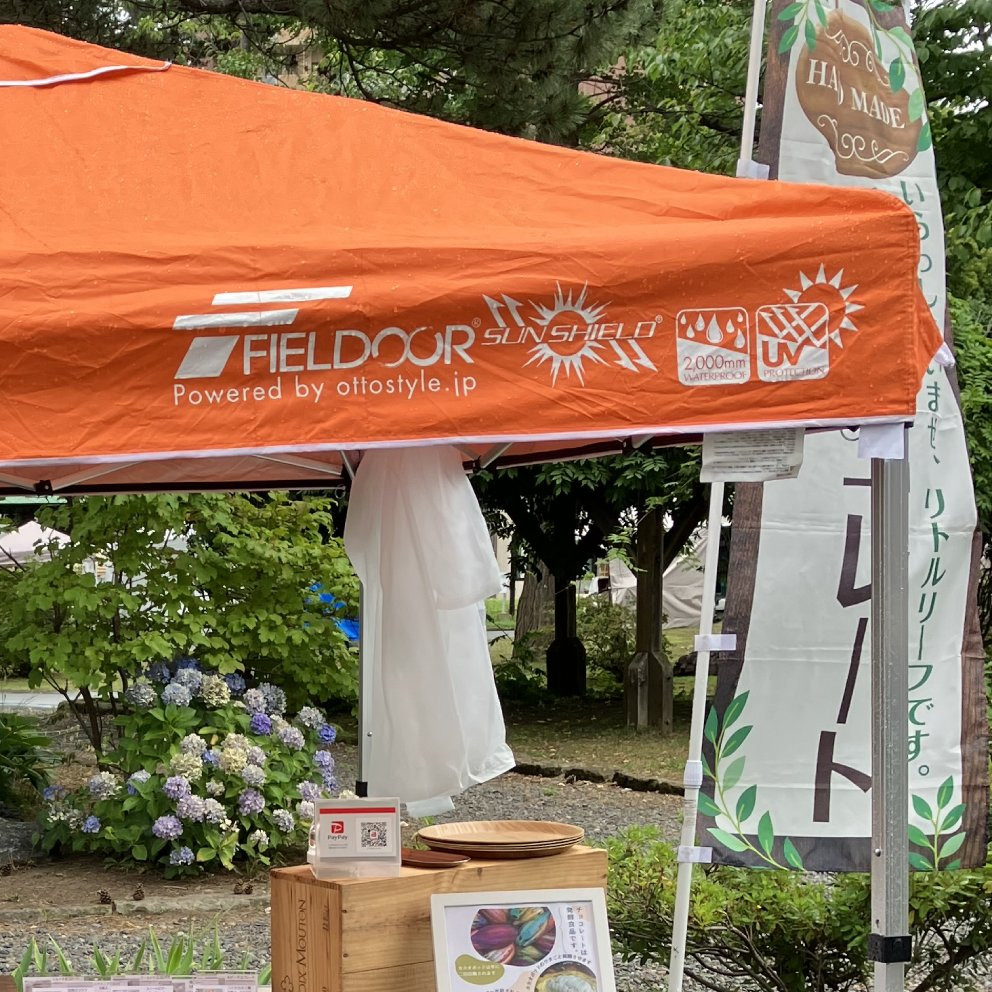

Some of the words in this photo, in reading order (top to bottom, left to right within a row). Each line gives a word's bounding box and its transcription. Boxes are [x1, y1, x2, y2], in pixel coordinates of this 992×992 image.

[851, 87, 906, 129] MADE
[480, 324, 548, 345] SUN
[550, 320, 657, 343] SHIELD
[683, 354, 746, 371] 2,000mm
[762, 339, 805, 368] UV
[173, 376, 283, 406] Powered
[295, 375, 324, 403] by
[336, 369, 477, 400] ottostyle.jp
[683, 370, 746, 382] WATERPROOF
[296, 899, 307, 966] MOUTON
[575, 906, 588, 956] チョコレートは
